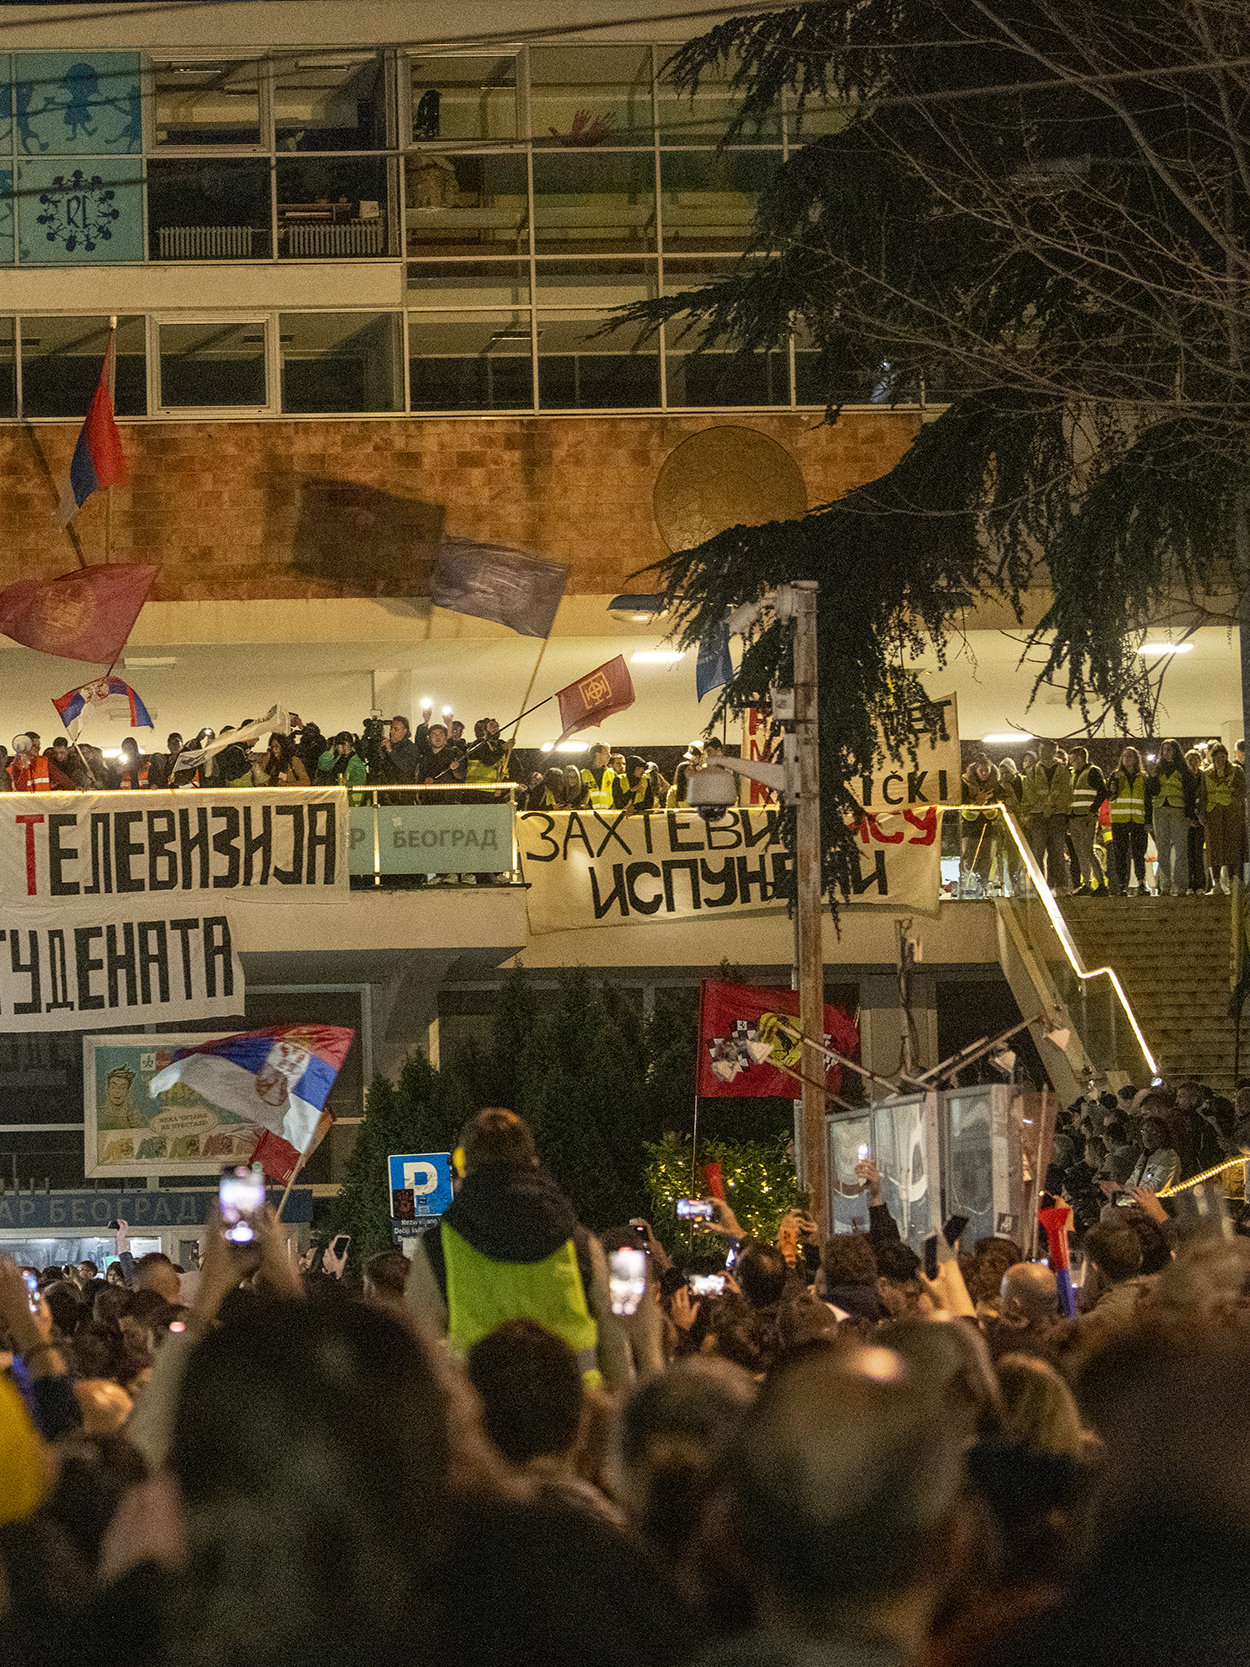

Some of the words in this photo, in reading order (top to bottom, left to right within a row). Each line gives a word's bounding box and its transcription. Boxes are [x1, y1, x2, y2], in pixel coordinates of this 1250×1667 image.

[16, 802, 336, 896] ТЕЛЕВИЗИЈА
[393, 828, 498, 850] БЕОГРАД
[521, 809, 779, 862] ЗАХТЕВИ
[587, 850, 889, 919] ИСПУЊЕИ
[50, 1196, 199, 1224] БЕОГРАД
